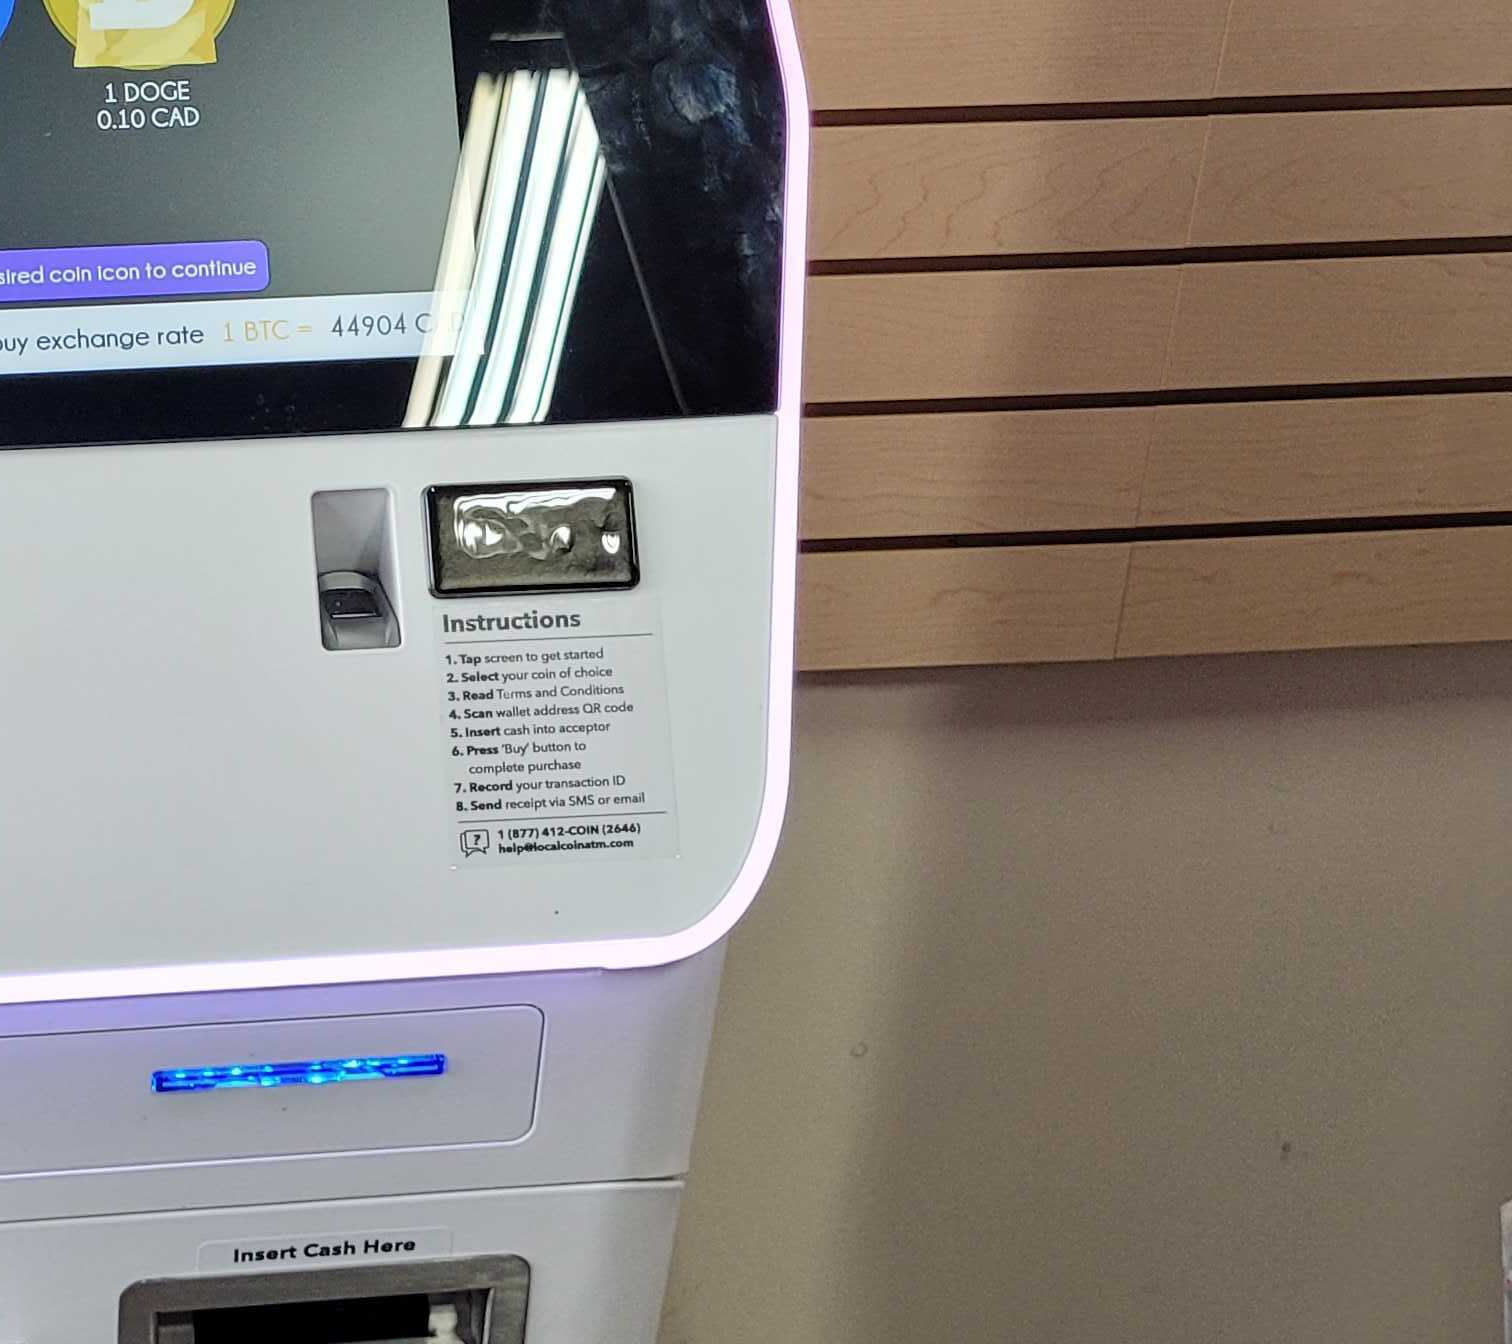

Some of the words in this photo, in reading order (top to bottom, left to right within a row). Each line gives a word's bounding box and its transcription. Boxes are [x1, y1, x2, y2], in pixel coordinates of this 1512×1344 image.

[105, 83, 116, 103] 1
[123, 81, 191, 102] DOGE
[98, 109, 146, 129] 0.10
[151, 107, 199, 128] CAD
[49, 265, 92, 284] coin
[97, 264, 140, 282] icon
[145, 262, 166, 280] to
[172, 259, 257, 278] continue
[35, 326, 150, 353] exchange
[156, 326, 205, 347] rate
[244, 319, 291, 342] BTC
[330, 314, 408, 338] 44904
[442, 610, 581, 633] Instructions
[445, 655, 458, 666] 1.
[459, 654, 482, 667] Tap
[484, 654, 523, 664] screen
[526, 652, 538, 662] to
[541, 651, 560, 663] get
[563, 647, 604, 660] started
[447, 673, 459, 683] 2.
[461, 671, 499, 682] Select
[501, 671, 528, 684] your
[531, 669, 556, 679] coin
[559, 666, 571, 678] of
[574, 666, 613, 677] choice
[448, 691, 460, 701] 3.
[463, 690, 494, 700] Read
[496, 688, 532, 699] Terms
[535, 686, 557, 697] and
[560, 685, 625, 696] Conditions
[449, 709, 461, 719] 4.
[464, 708, 493, 718] Scan
[496, 706, 531, 717] wallet
[534, 704, 580, 715] address
[582, 703, 601, 714] QR
[604, 702, 634, 712] code
[451, 727, 463, 738] 5.
[465, 726, 501, 737] Insert
[503, 725, 530, 735] cash
[533, 723, 556, 734] into
[559, 722, 610, 735] acceptor
[452, 746, 464, 756] 6.
[467, 746, 498, 756] Press
[533, 741, 571, 752] button
[575, 742, 586, 751] to
[469, 762, 524, 775] complete
[528, 760, 581, 774] purchase
[454, 783, 466, 793] 7.
[470, 781, 513, 792] Record
[516, 780, 542, 793] your
[545, 776, 609, 789] transaction
[613, 775, 625, 785] ID
[456, 802, 468, 811] 8.
[471, 799, 502, 810] Send
[505, 798, 546, 811] receipt
[549, 797, 565, 807] via
[568, 795, 594, 806] SMS
[598, 795, 610, 804] or
[613, 792, 645, 804] email
[498, 829, 504, 839] 1
[508, 828, 539, 840] (877)
[542, 825, 599, 837] 412-COIN
[602, 823, 641, 835] (2646)
[233, 1246, 297, 1263] Insert
[304, 1240, 356, 1257] Cash
[363, 1239, 416, 1254] Here
